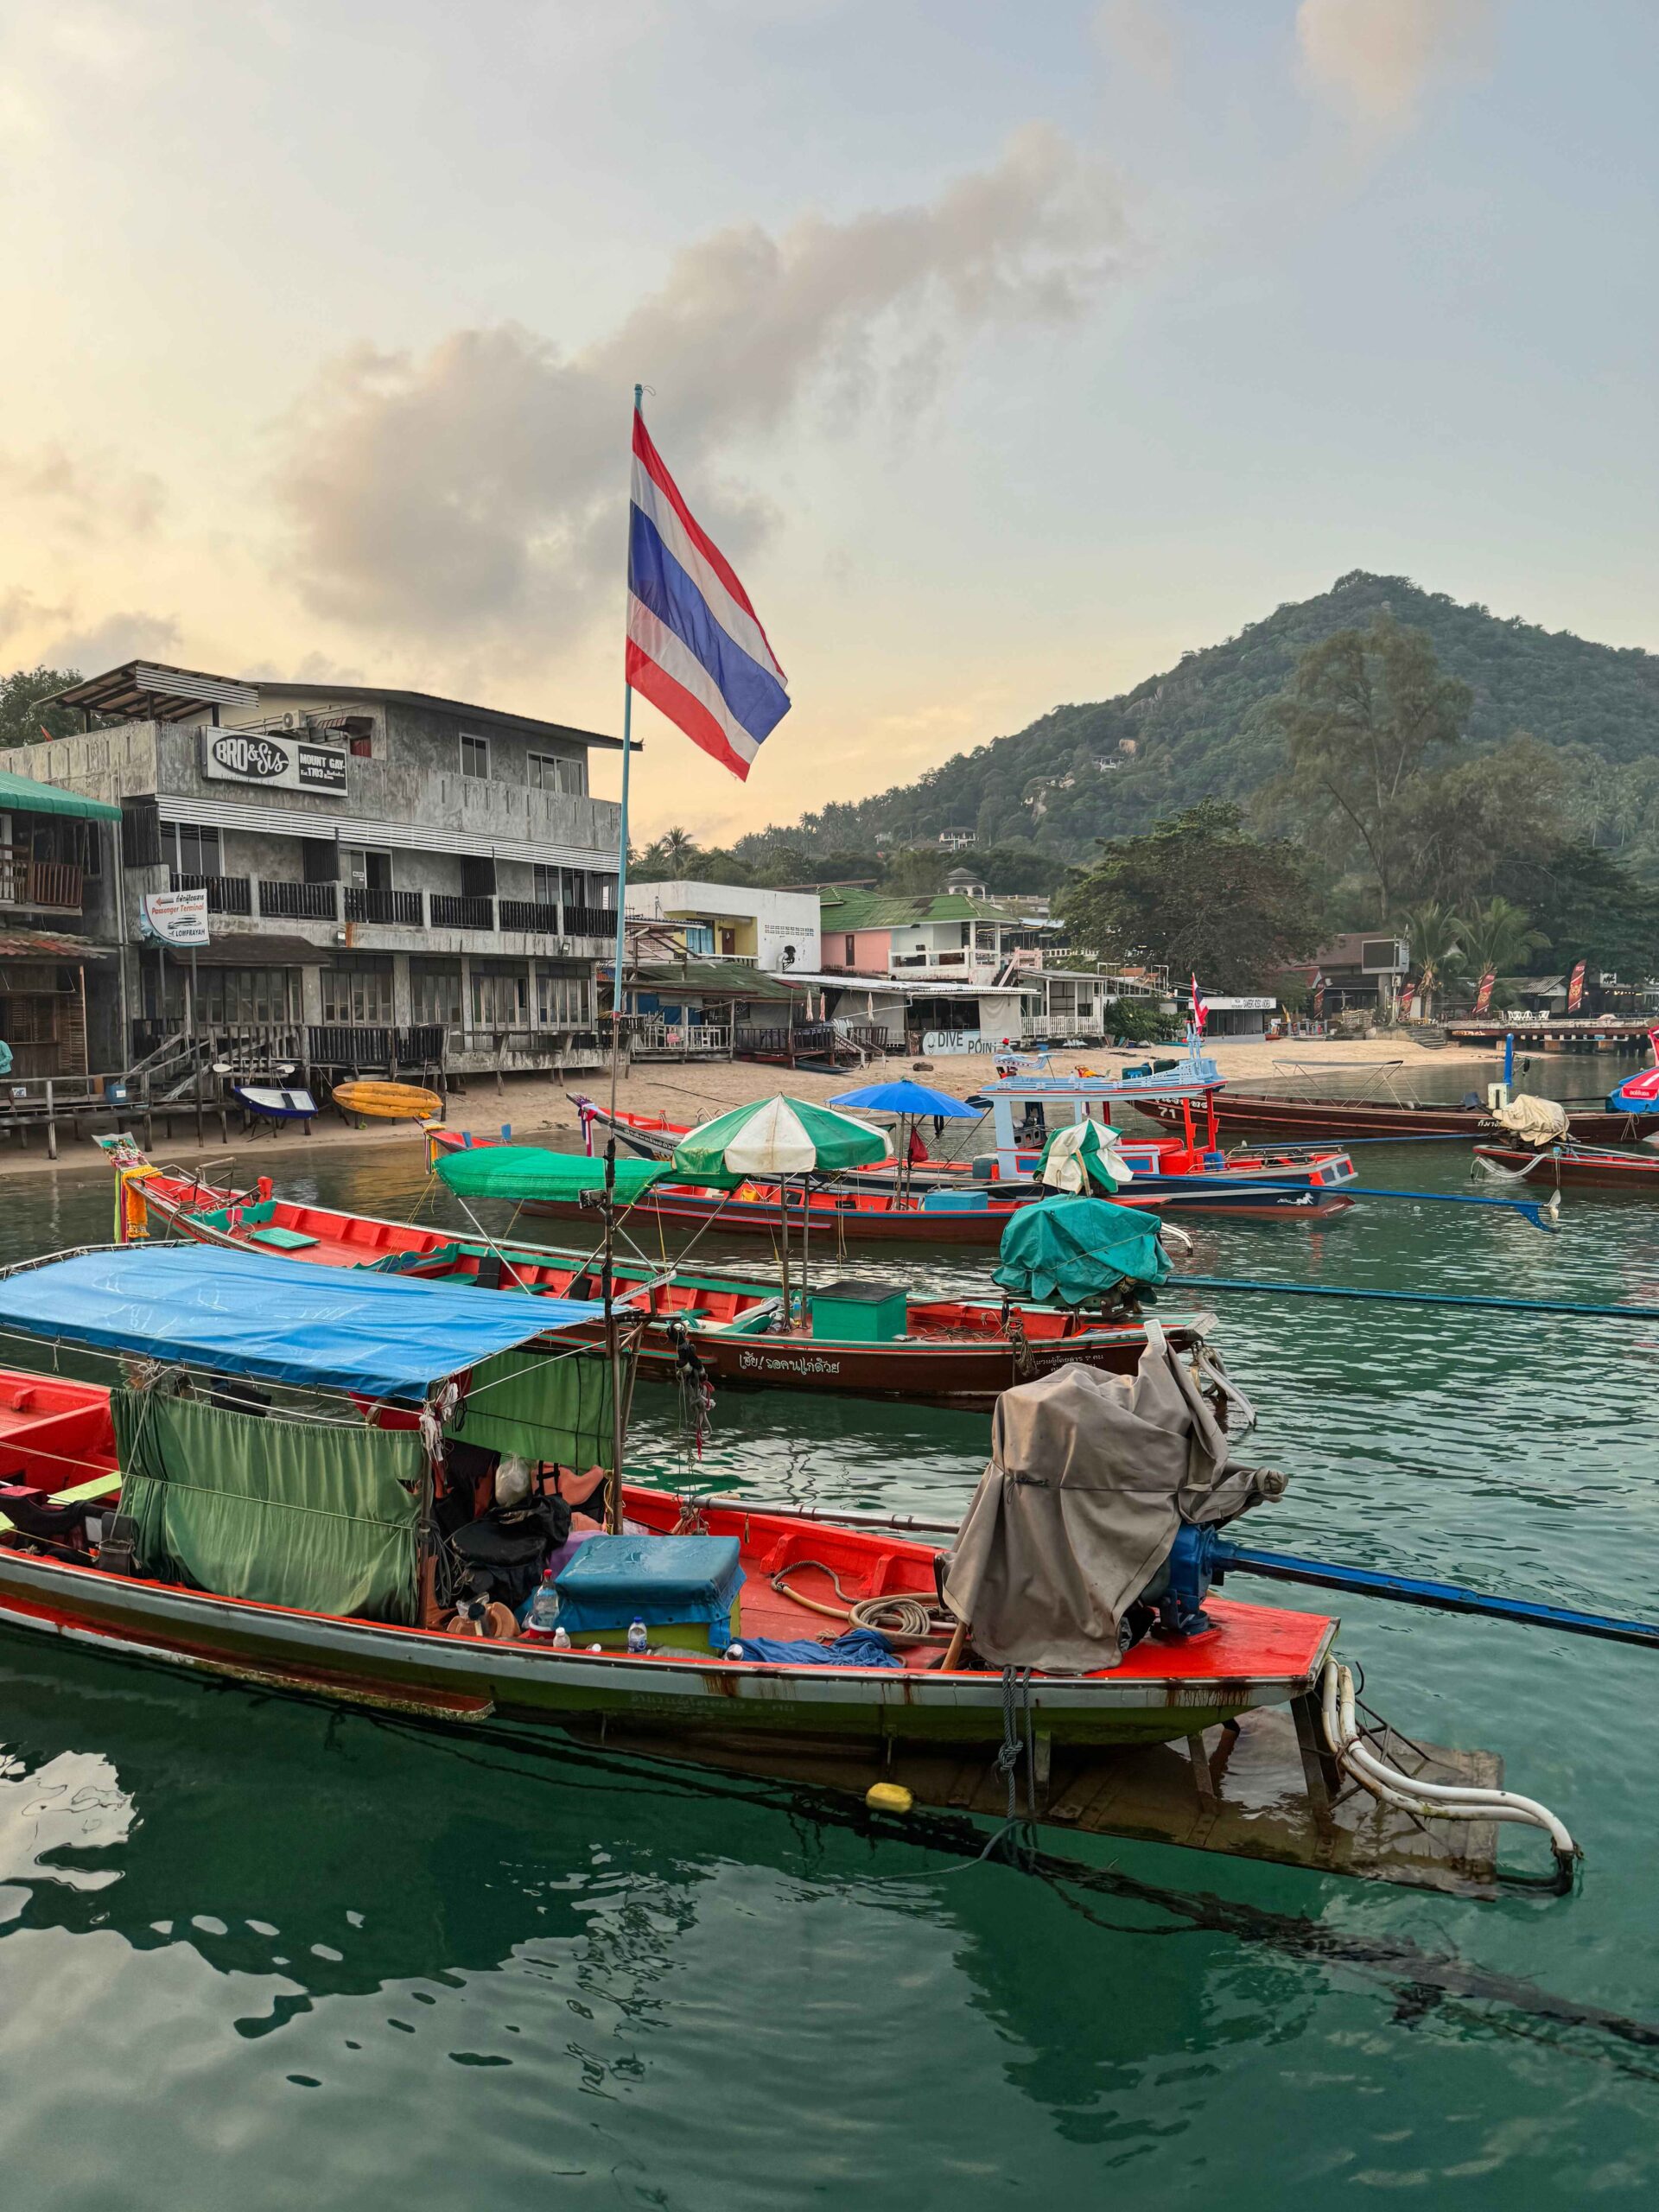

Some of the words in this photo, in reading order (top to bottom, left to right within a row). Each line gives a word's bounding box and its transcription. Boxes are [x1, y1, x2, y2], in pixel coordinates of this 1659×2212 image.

[300, 753, 327, 768] MOUNT
[152, 906, 179, 915] Passenger
[181, 903, 204, 912] Terminal
[938, 1031, 963, 1047] DIVE
[1158, 1106, 1176, 1119] 71
